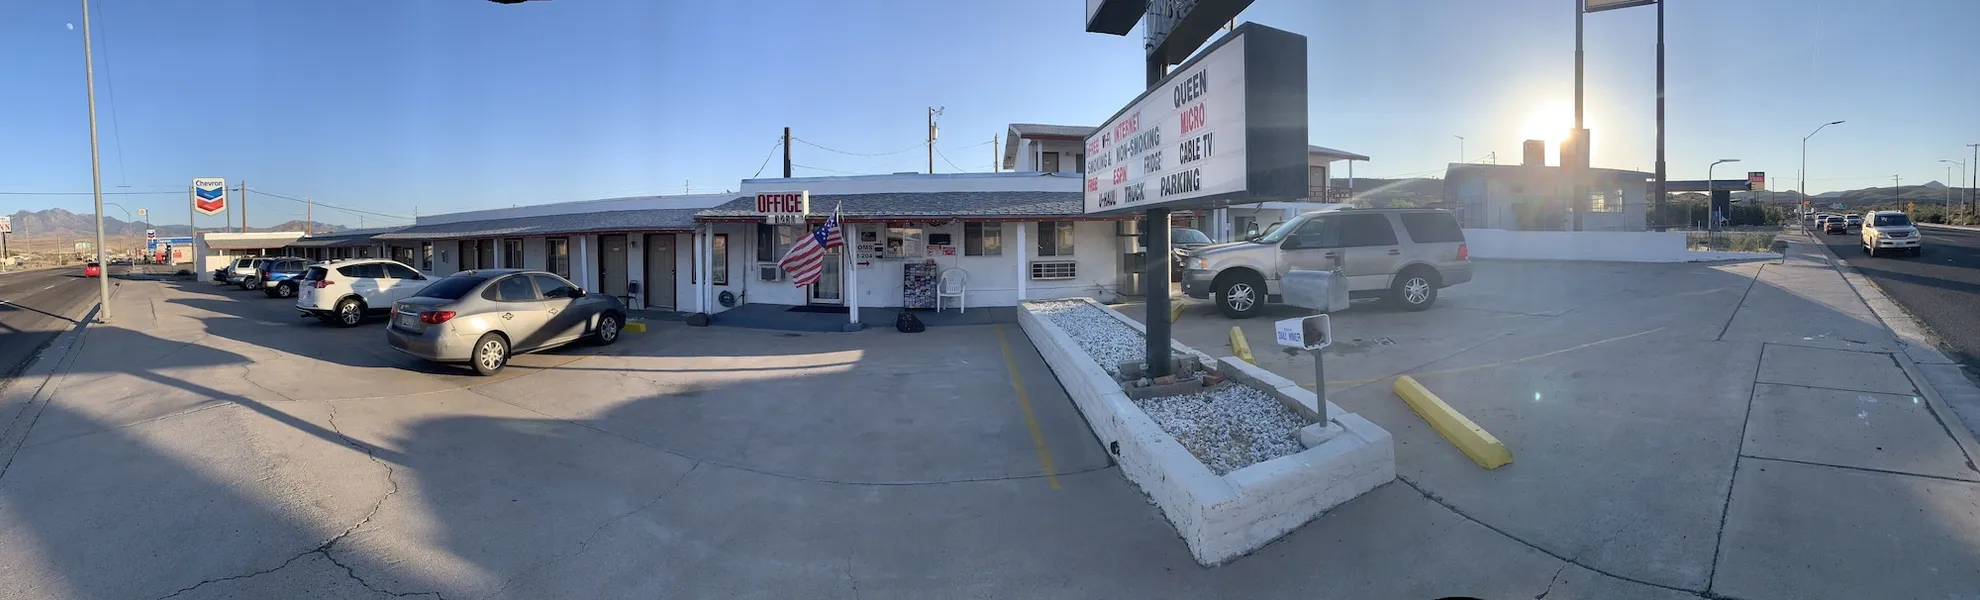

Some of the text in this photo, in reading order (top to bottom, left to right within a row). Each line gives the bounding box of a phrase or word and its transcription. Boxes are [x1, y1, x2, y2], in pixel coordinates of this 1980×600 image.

[1113, 112, 1140, 142] INTERNET
[1173, 69, 1207, 108] QUEEN
[1087, 152, 1107, 174] SMOKING
[1116, 126, 1160, 163] NON-SMOKING
[1180, 102, 1205, 135] MICRO
[1087, 132, 1213, 192] FREE ESPN FRIDGE CABLE TV
[757, 194, 802, 213] OFFICE
[1124, 182, 1145, 203] TRUCK
[1160, 168, 1200, 197] PARKING
